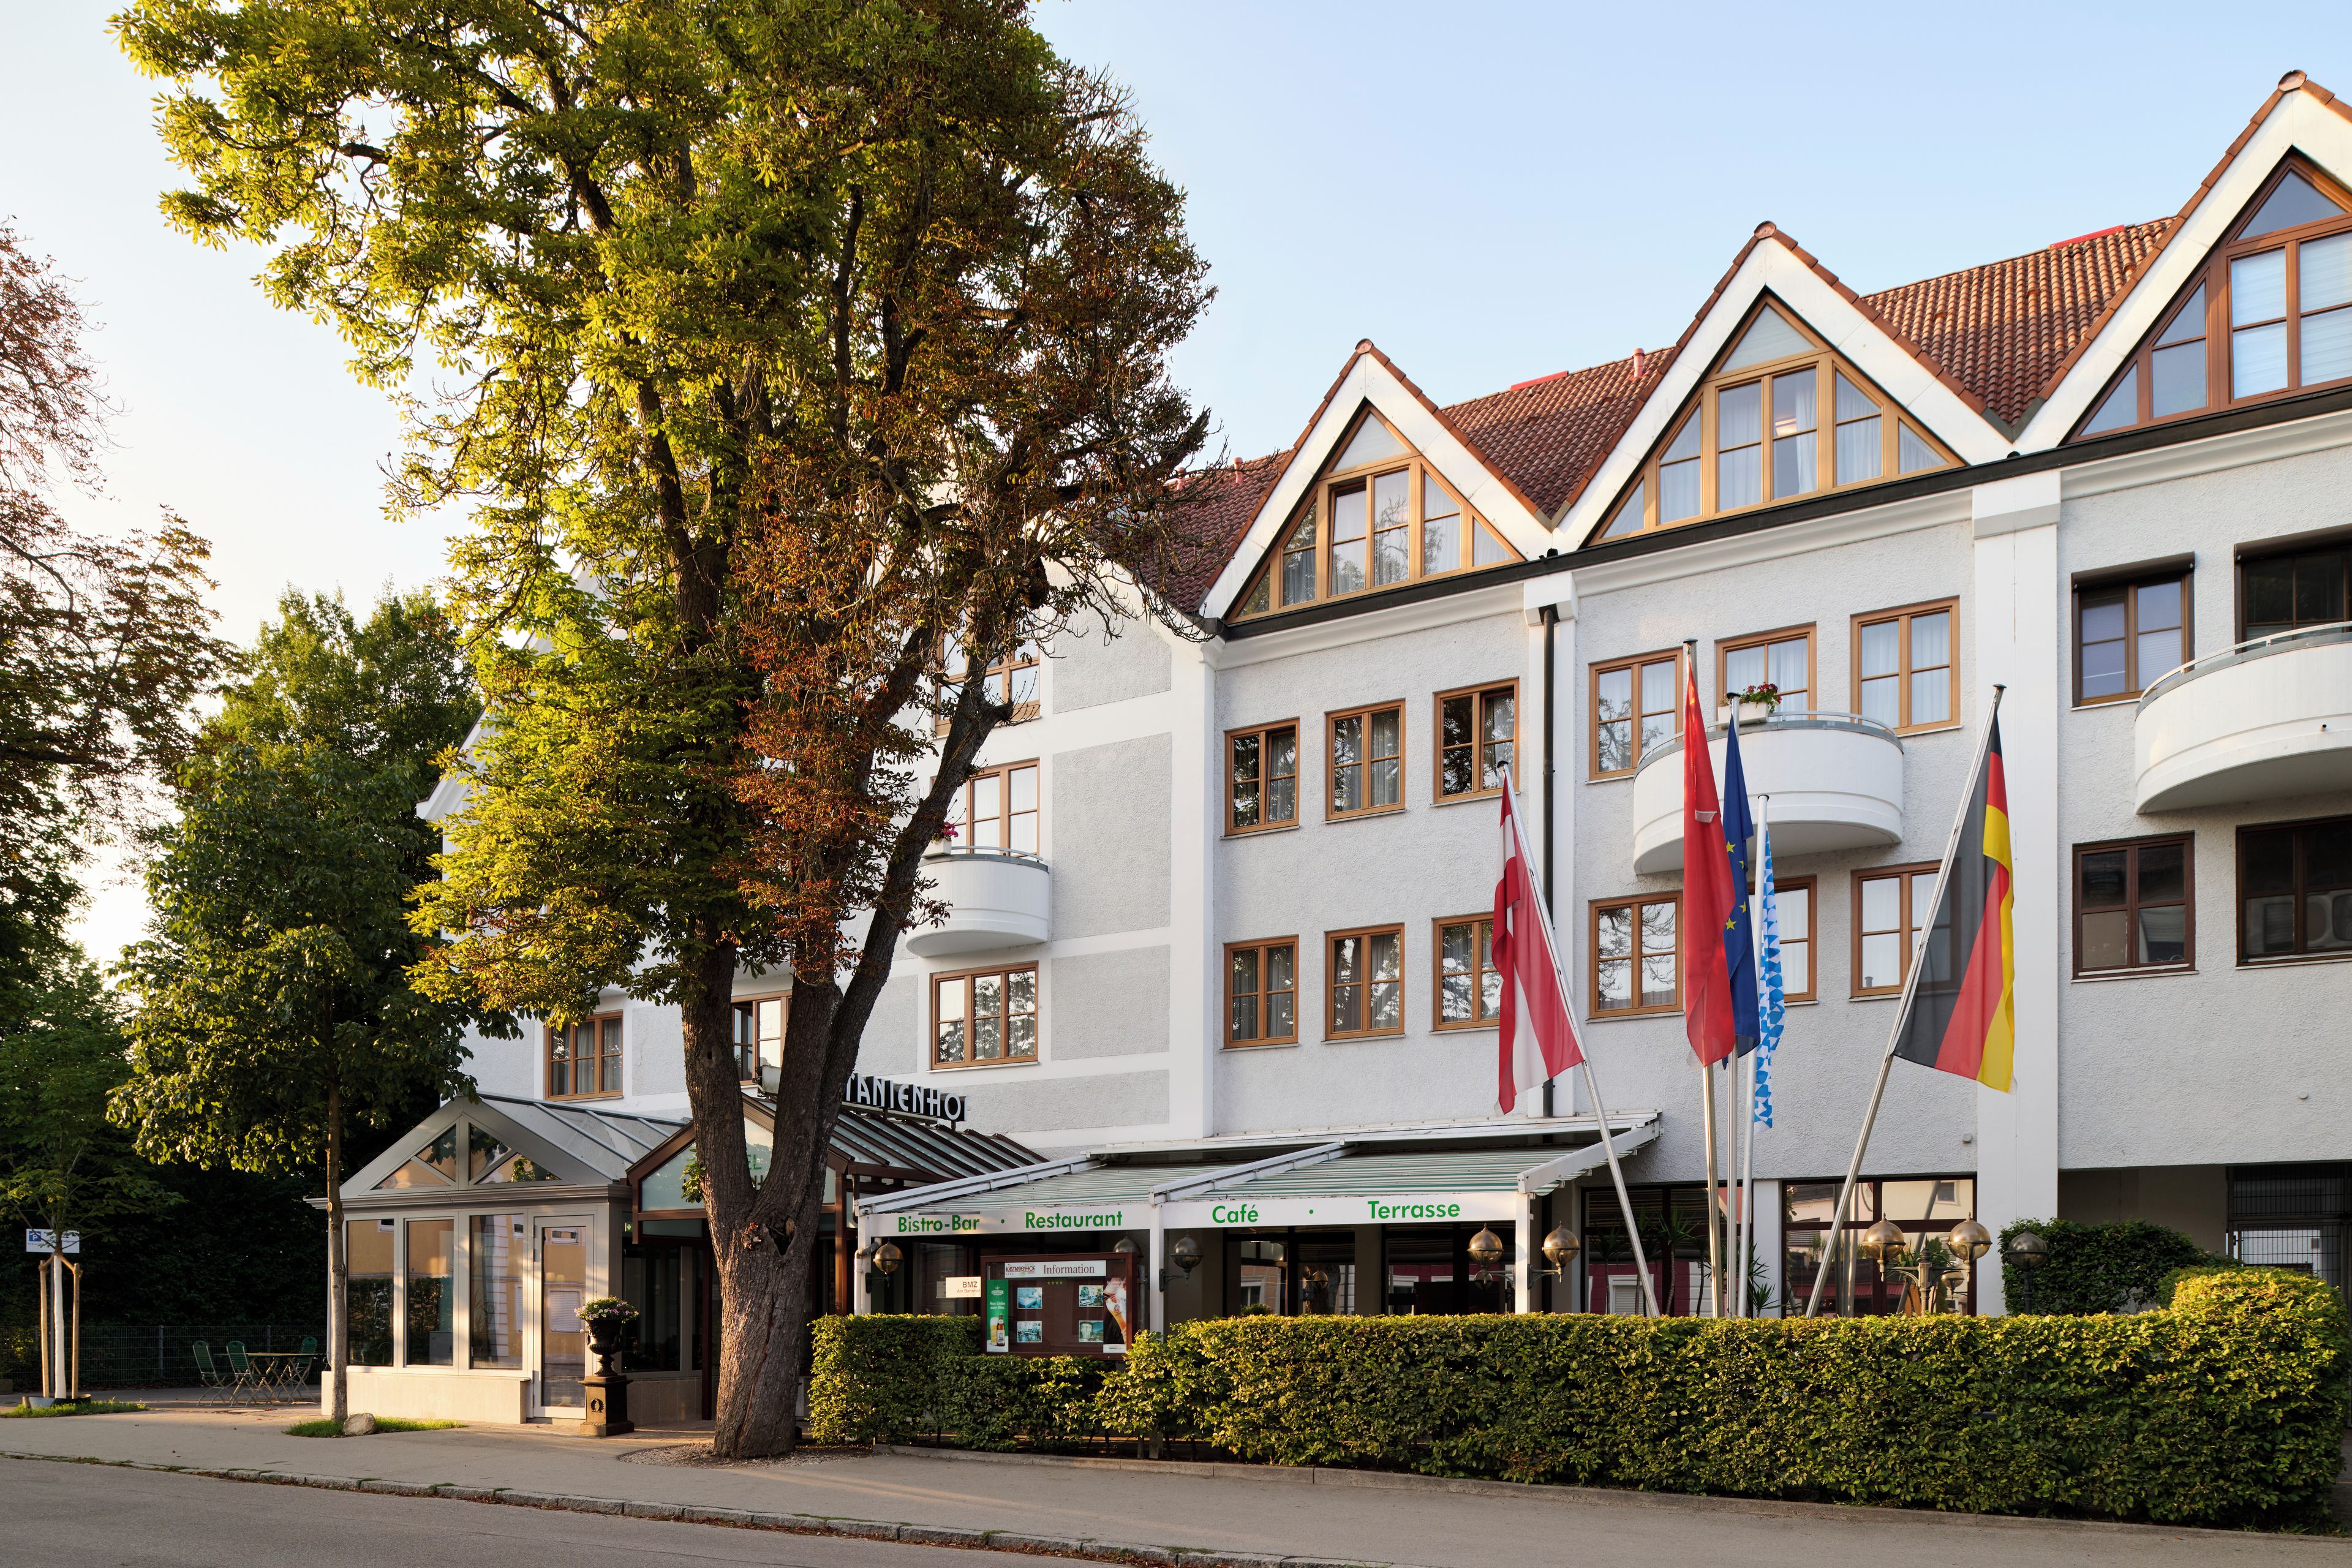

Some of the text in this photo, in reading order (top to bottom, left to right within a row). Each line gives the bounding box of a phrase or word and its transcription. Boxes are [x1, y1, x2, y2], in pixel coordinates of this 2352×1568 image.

[898, 1210, 1123, 1232] Bistro-Bar Restaurant
[1212, 1200, 1461, 1224] Café Terrasse
[1043, 1264, 1095, 1274] Information
